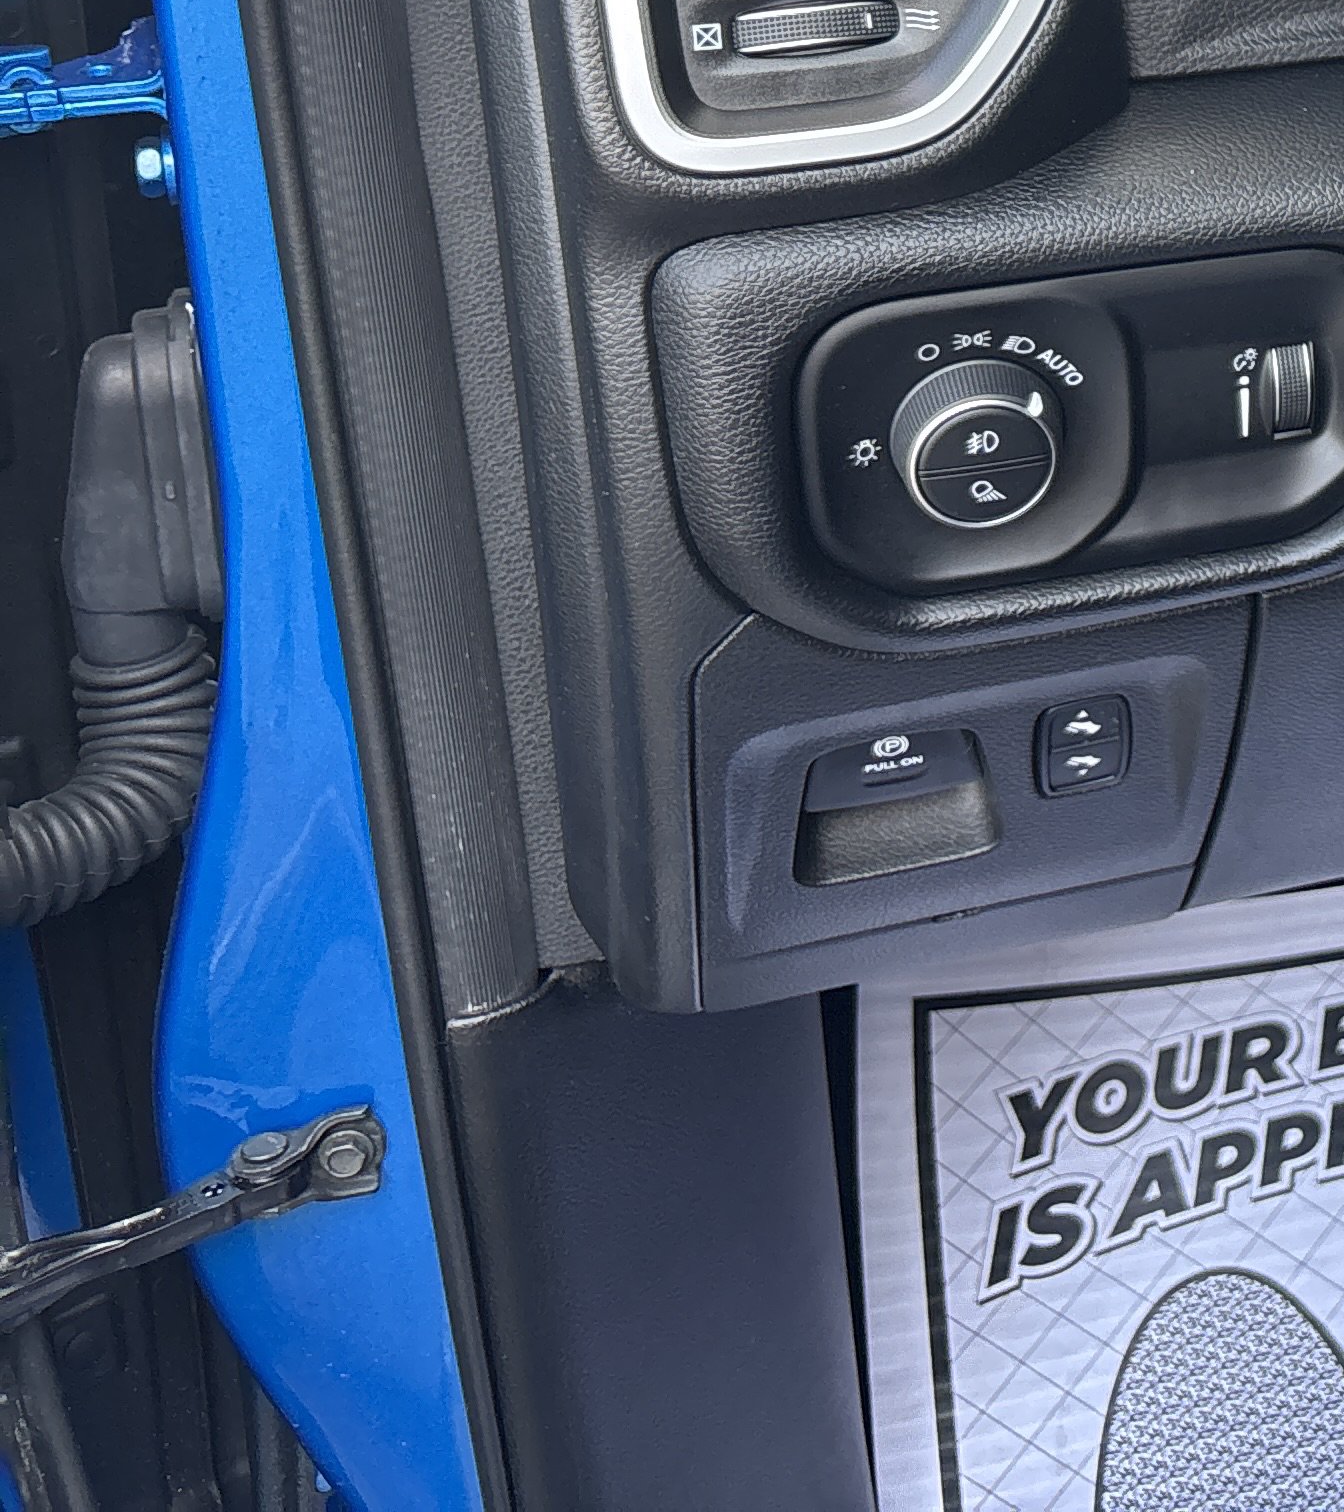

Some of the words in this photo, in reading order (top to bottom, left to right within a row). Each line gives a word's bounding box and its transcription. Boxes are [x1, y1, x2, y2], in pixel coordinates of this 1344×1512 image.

[1035, 347, 1085, 388] AUTO
[863, 760, 898, 773] PULL
[899, 754, 924, 767] ON
[1002, 1020, 1294, 1168] YOUR
[983, 1176, 1094, 1292] IS
